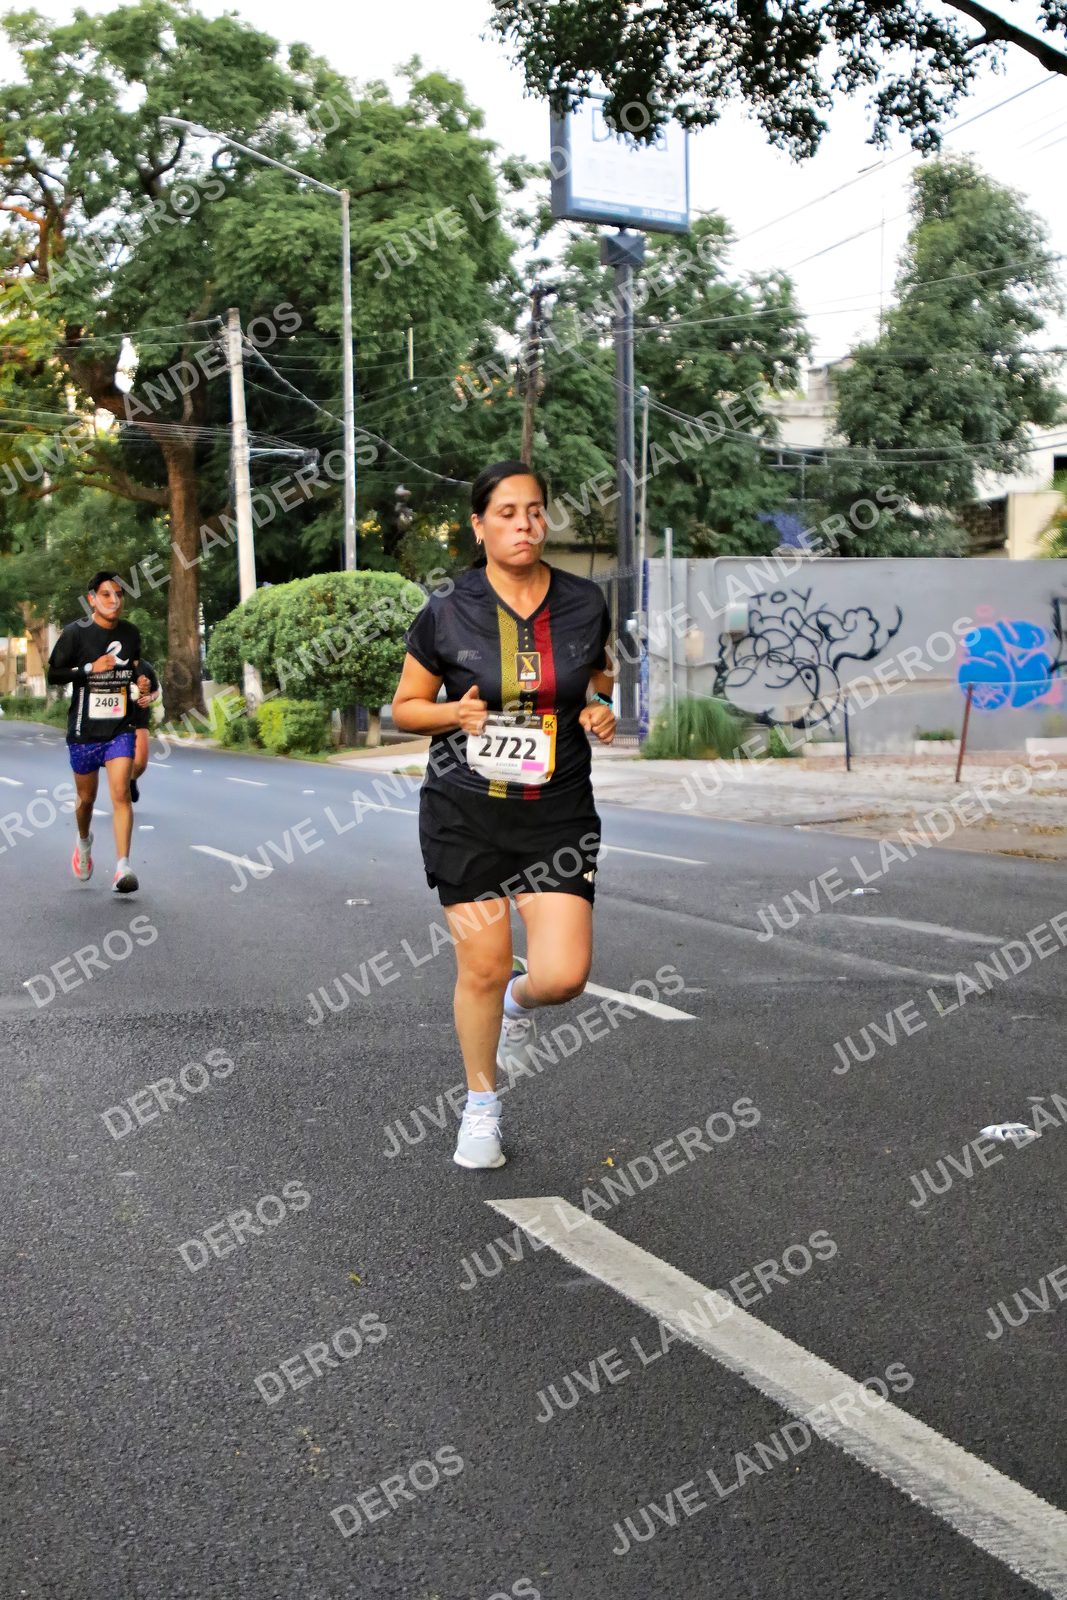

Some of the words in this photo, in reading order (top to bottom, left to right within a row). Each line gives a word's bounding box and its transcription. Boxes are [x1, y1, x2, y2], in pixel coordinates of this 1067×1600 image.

[750, 587, 812, 611] TOY
[95, 697, 119, 707] 2403
[544, 720, 554, 729] 5K
[478, 734, 537, 760] 2722
